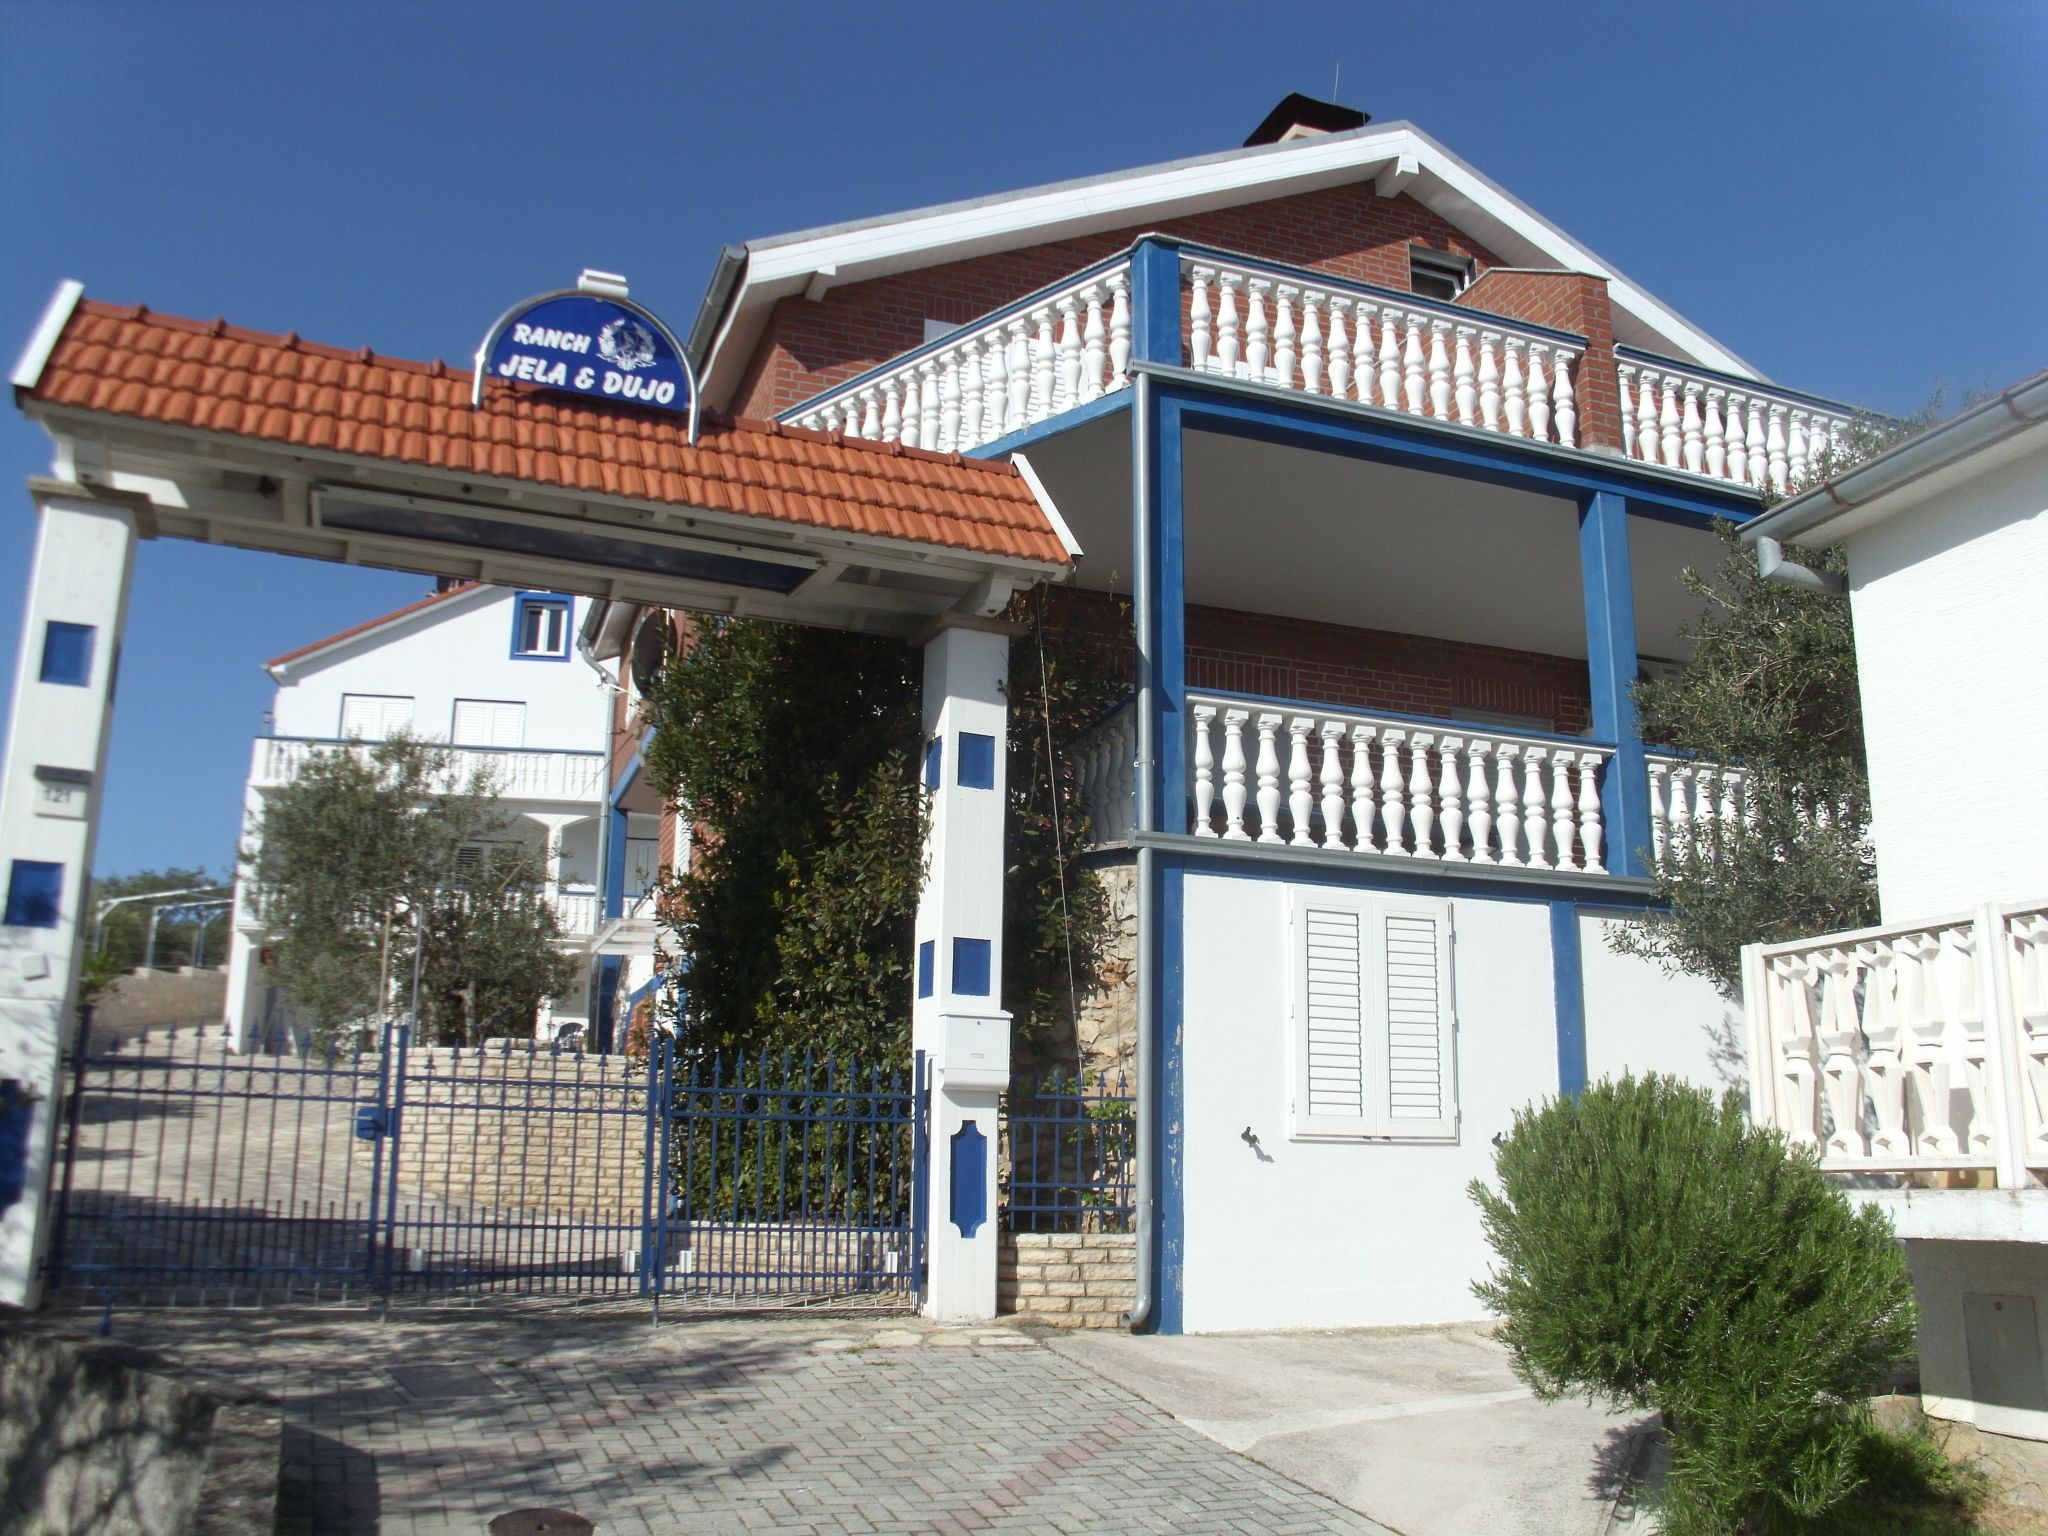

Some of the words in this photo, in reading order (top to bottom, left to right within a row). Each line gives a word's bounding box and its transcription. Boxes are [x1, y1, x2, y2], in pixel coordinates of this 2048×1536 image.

[513, 323, 591, 354] RANCH
[499, 354, 567, 386] JELA
[574, 367, 595, 390] &
[602, 371, 676, 404] DUJO
